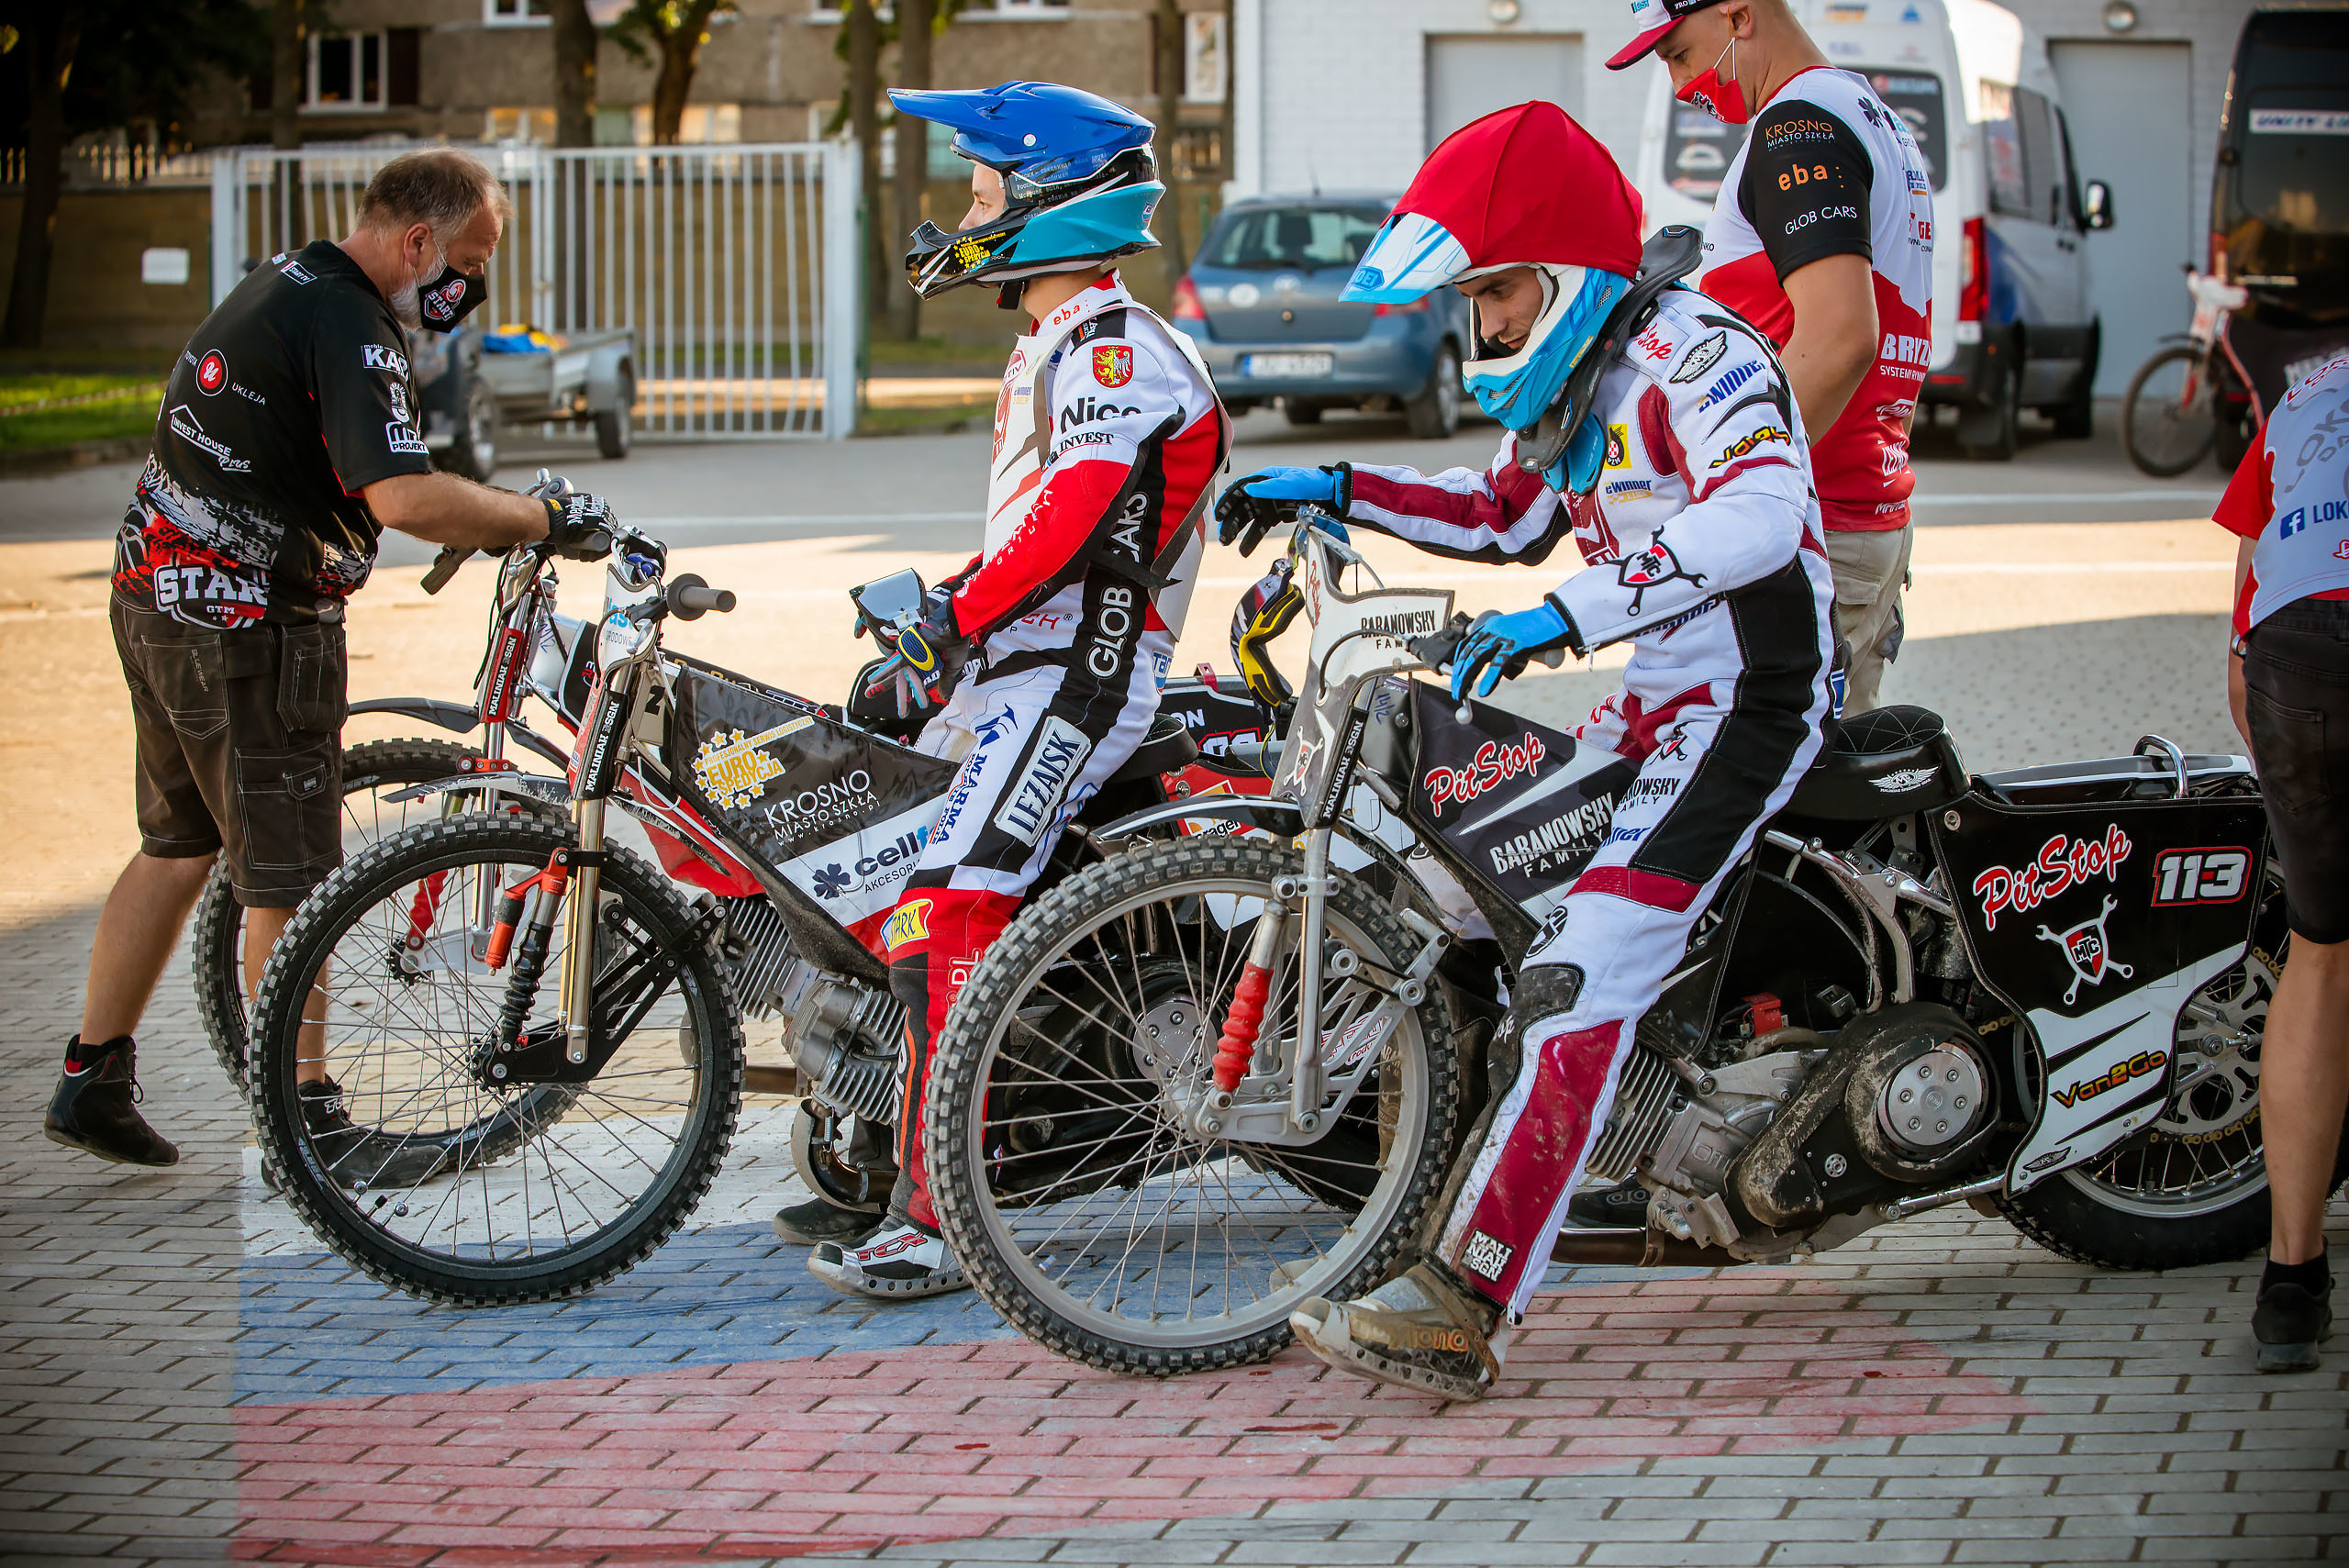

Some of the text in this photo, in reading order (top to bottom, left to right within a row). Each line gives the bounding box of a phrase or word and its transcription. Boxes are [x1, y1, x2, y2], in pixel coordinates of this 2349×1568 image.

[1765, 120, 1833, 140] KROSNO
[1767, 133, 1802, 148] MIASTO
[1805, 131, 1835, 140] SZKŁA
[1785, 206, 1857, 235] GLOB CARS
[428, 292, 454, 318] START
[231, 382, 266, 406] UKLEJA
[172, 416, 232, 456] INVEST HOUSE
[393, 442, 426, 451] PROJEKT
[1060, 431, 1114, 452] INVEST
[206, 606, 235, 615] GTM
[1361, 610, 1435, 639] BARANOWSKY
[1088, 586, 1133, 678] GLOB
[489, 665, 508, 716] MALINIAK
[704, 717, 814, 766] PROFESJONALNY SERWIS LOGISTYCZNY
[585, 734, 608, 793] MALINIAK
[707, 751, 758, 782] EURO
[718, 760, 784, 796] SPEDYCJA
[1425, 732, 1546, 817] PitStop
[764, 769, 871, 828] KROSNO
[936, 753, 988, 845] MARMA
[1323, 752, 1349, 819] MALINIAK
[774, 791, 878, 841] MIASTO SZKŁA
[777, 803, 881, 847] www.krosno.pl
[1489, 792, 1615, 874] BARANOWSKY
[1524, 829, 1604, 878] FAMILY
[1973, 822, 2132, 932] PitStop
[2157, 852, 2247, 902] 113
[2073, 936, 2100, 962] MTC
[2050, 1050, 2168, 1109] Van2Go
[1467, 1242, 1508, 1270] NIAK
[1472, 1230, 1513, 1259] MALI
